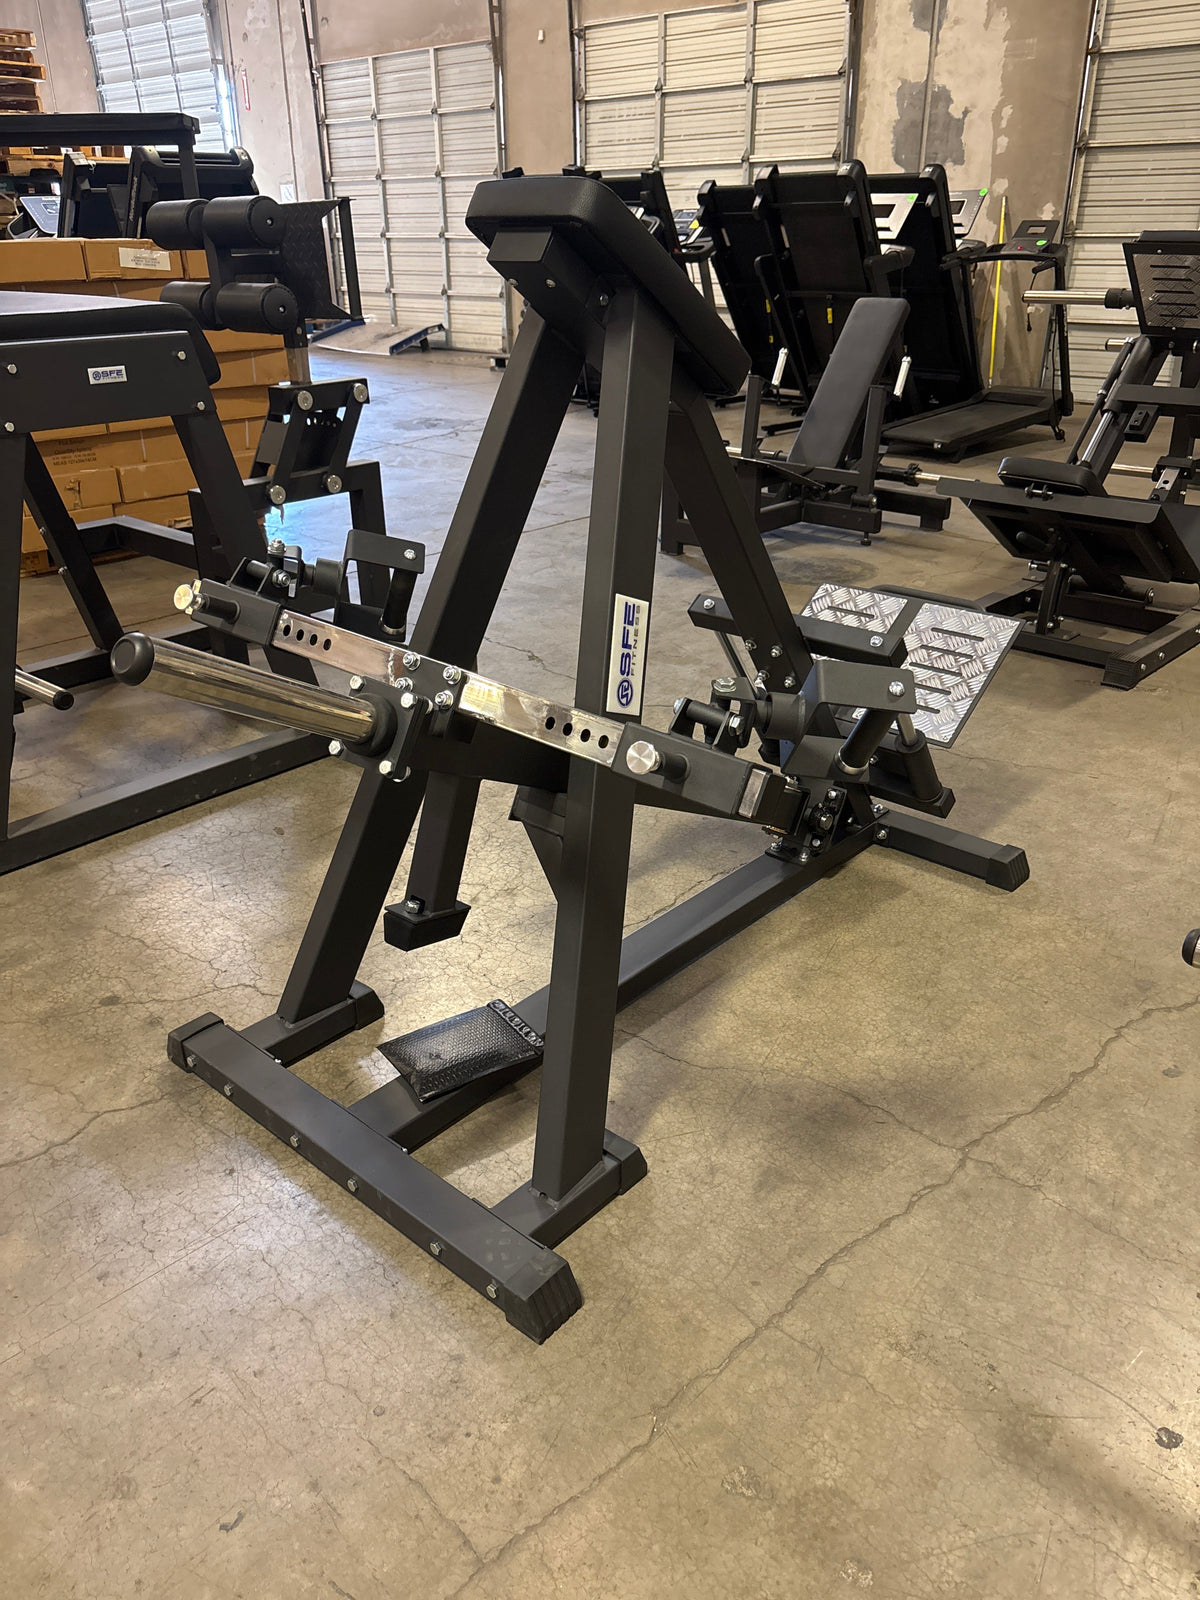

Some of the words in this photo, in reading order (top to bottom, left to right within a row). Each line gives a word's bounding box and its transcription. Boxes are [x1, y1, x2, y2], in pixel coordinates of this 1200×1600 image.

[101, 369, 124, 377] SFE
[620, 602, 635, 676] SFE
[631, 605, 640, 676] FITNESS
